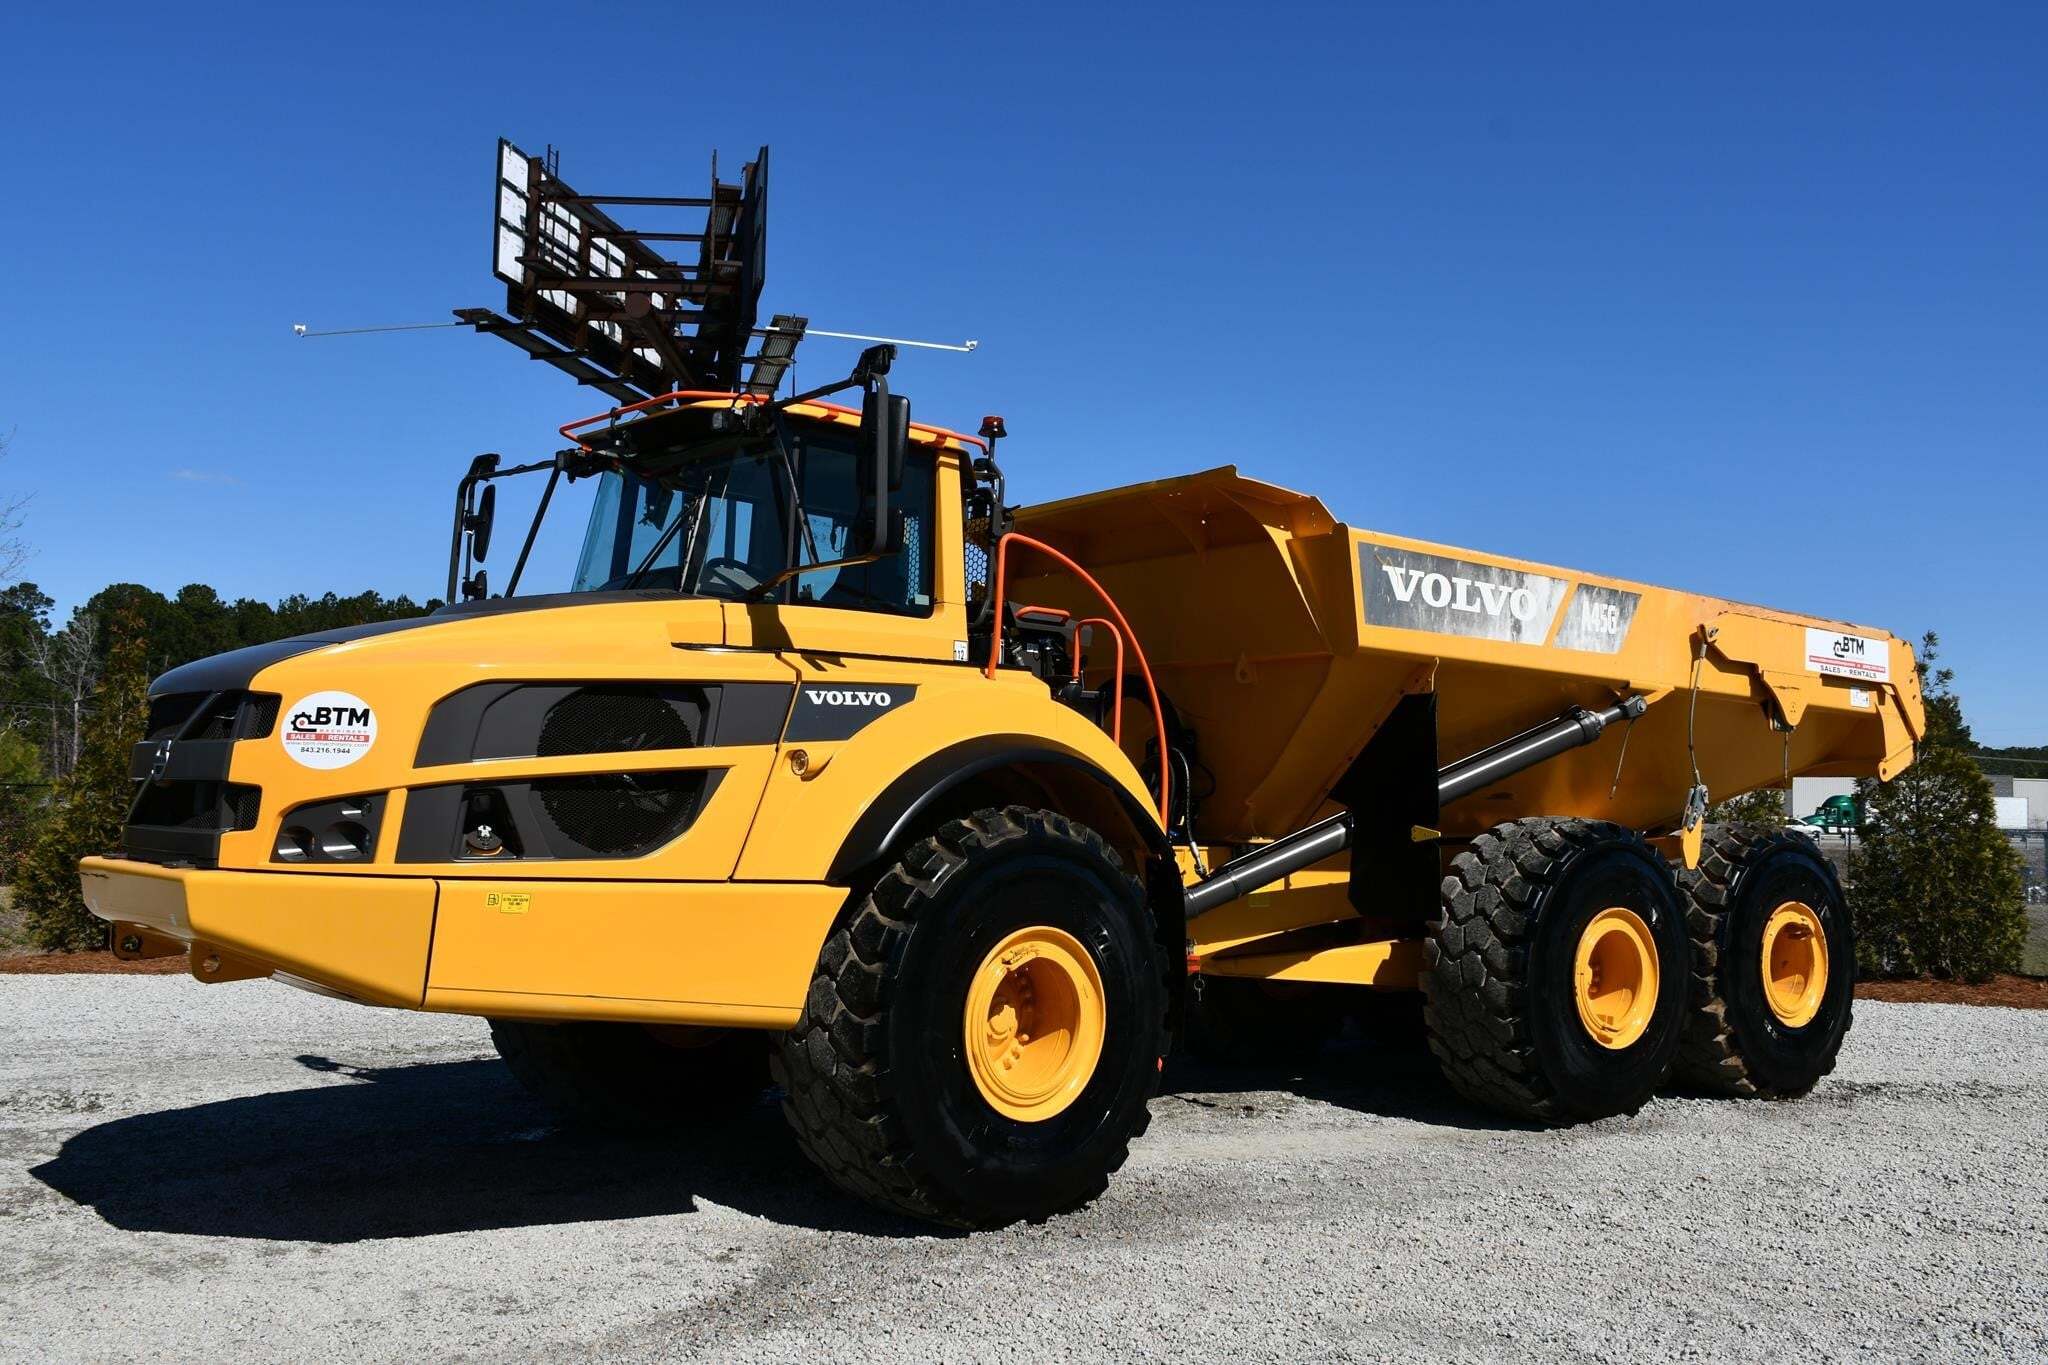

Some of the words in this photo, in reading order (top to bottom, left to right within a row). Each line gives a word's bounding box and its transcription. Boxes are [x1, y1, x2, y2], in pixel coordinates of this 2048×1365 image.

[1382, 565, 1537, 622] VOLVO
[1841, 636, 1865, 655] BTM
[1820, 664, 1841, 674] SALES
[1849, 669, 1877, 679] RENTALS
[805, 690, 891, 706] VOLVO
[315, 707, 370, 727] BTM
[328, 734, 365, 742] RENTALS
